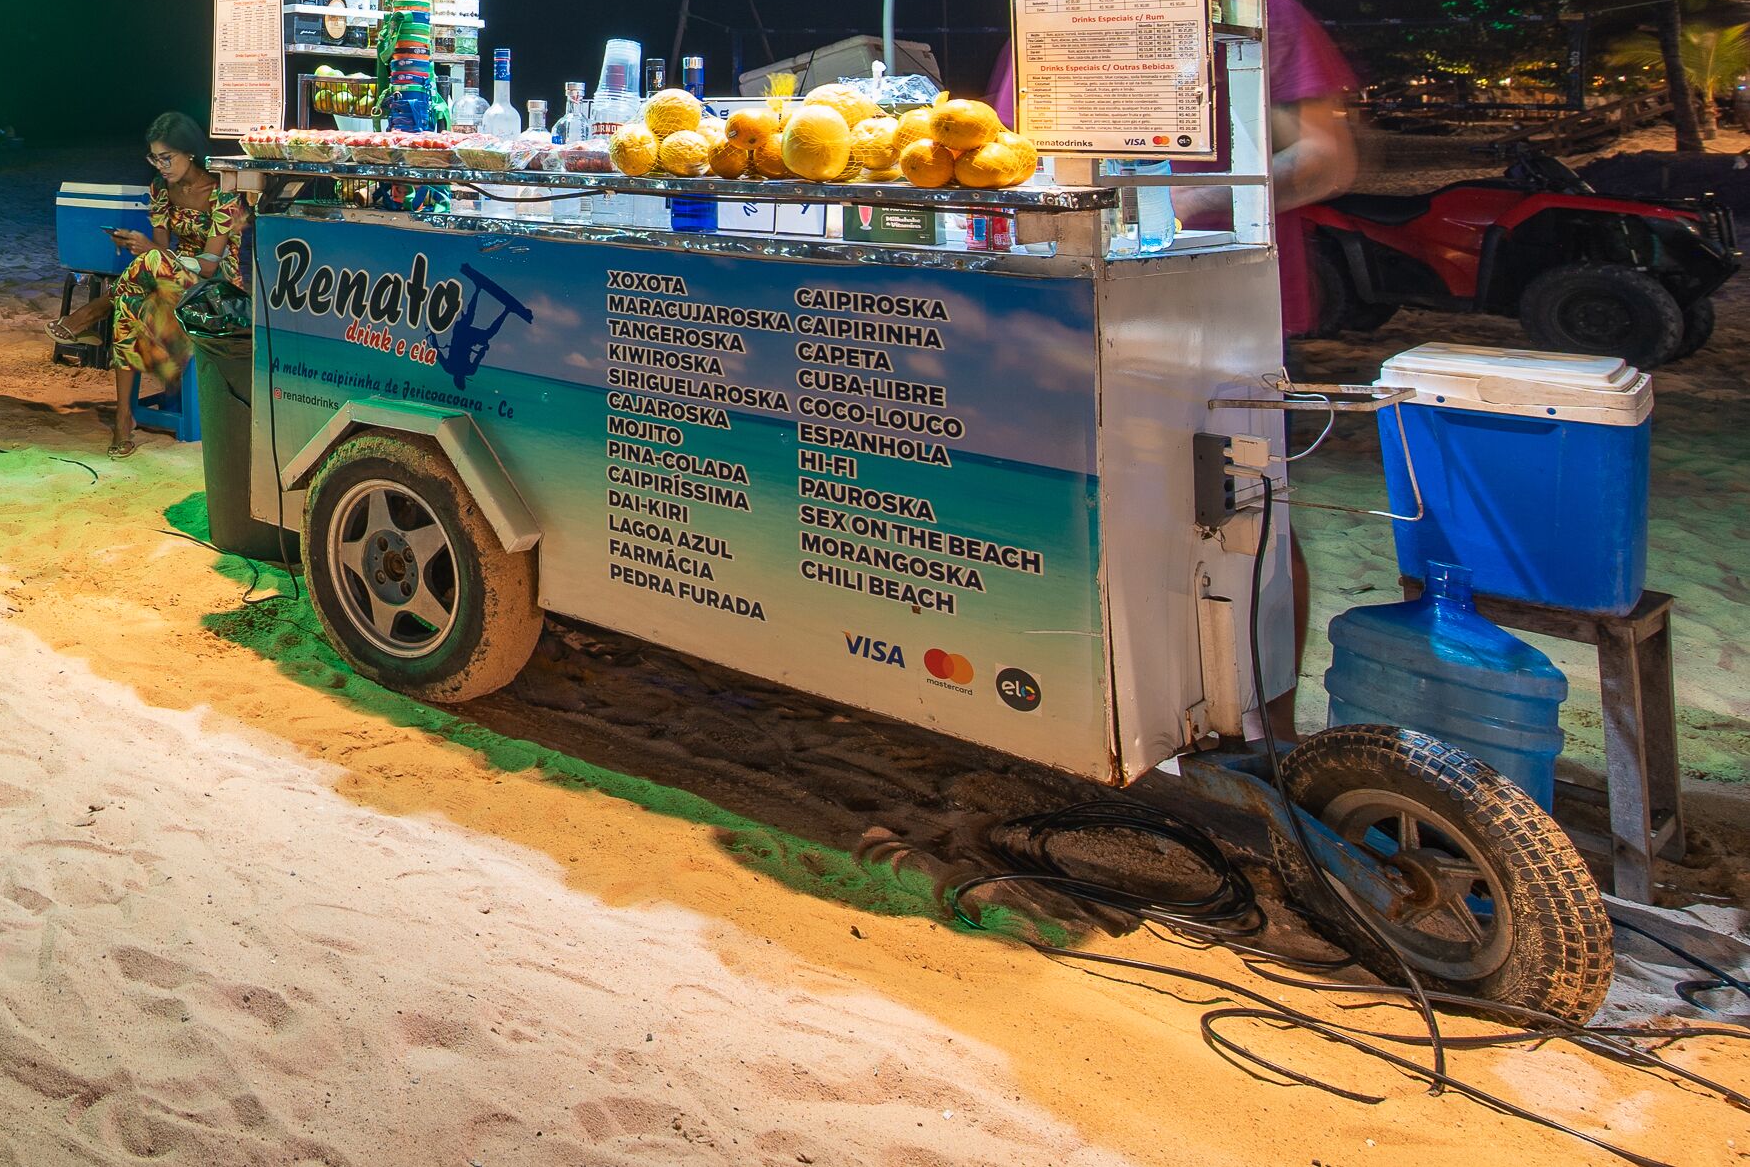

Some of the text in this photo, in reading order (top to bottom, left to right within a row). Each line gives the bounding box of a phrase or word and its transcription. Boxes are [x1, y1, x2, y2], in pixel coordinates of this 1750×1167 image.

[1071, 16, 1096, 24] Drinks
[1098, 15, 1133, 24] Especiais
[1135, 14, 1143, 22] c/
[1066, 64, 1100, 73] Especiais
[1102, 63, 1111, 72] C/
[1113, 63, 1140, 71] Outras
[1142, 62, 1175, 71] Bebidas
[1036, 139, 1094, 147] renatodrinks
[1124, 138, 1147, 146] VISA
[270, 238, 463, 333] Renato
[608, 270, 688, 295] XOXOTA
[608, 294, 793, 334] MARACUJAROSKA
[795, 288, 950, 322] CAIPIROSKA
[345, 318, 438, 366] drink e cia
[608, 319, 745, 353] TANGEROSKA
[796, 316, 944, 350] CAIPIRINHA
[608, 343, 724, 377] KIWIROSKA
[796, 343, 893, 373] CAPETA
[272, 356, 280, 372] A
[282, 359, 318, 381] melhor
[322, 368, 380, 393] caipirinha
[385, 377, 399, 394] de
[402, 380, 483, 412] Jericoacoara
[498, 400, 514, 419] Ce
[283, 389, 340, 411] renatodrinks
[608, 368, 791, 413] SIRIGUELAROSKA
[797, 370, 946, 408] CUBA-LIBRE
[608, 392, 731, 430] CAJAROSKA
[608, 416, 683, 445] MOJITO
[797, 396, 965, 439] COCO-LOUCO
[608, 440, 749, 485] PINA-COLADA
[798, 423, 952, 467] ESPANHOLA
[799, 450, 857, 479] HI-FI
[607, 465, 751, 512] CAIPIRÍSSIMA
[608, 490, 689, 524] DAI-KIRI
[799, 478, 937, 524] PAUROSKA
[608, 514, 734, 561] LAGOA AZUL
[799, 506, 1043, 576] SEX ON THE BEACH
[609, 539, 714, 582] FARMÁCIA
[800, 532, 986, 594] MORANGOSKA
[610, 563, 766, 622] PEDRA FURADA
[800, 560, 956, 616] CHILI BEACH
[842, 631, 1035, 701] VISA mastercard elo
